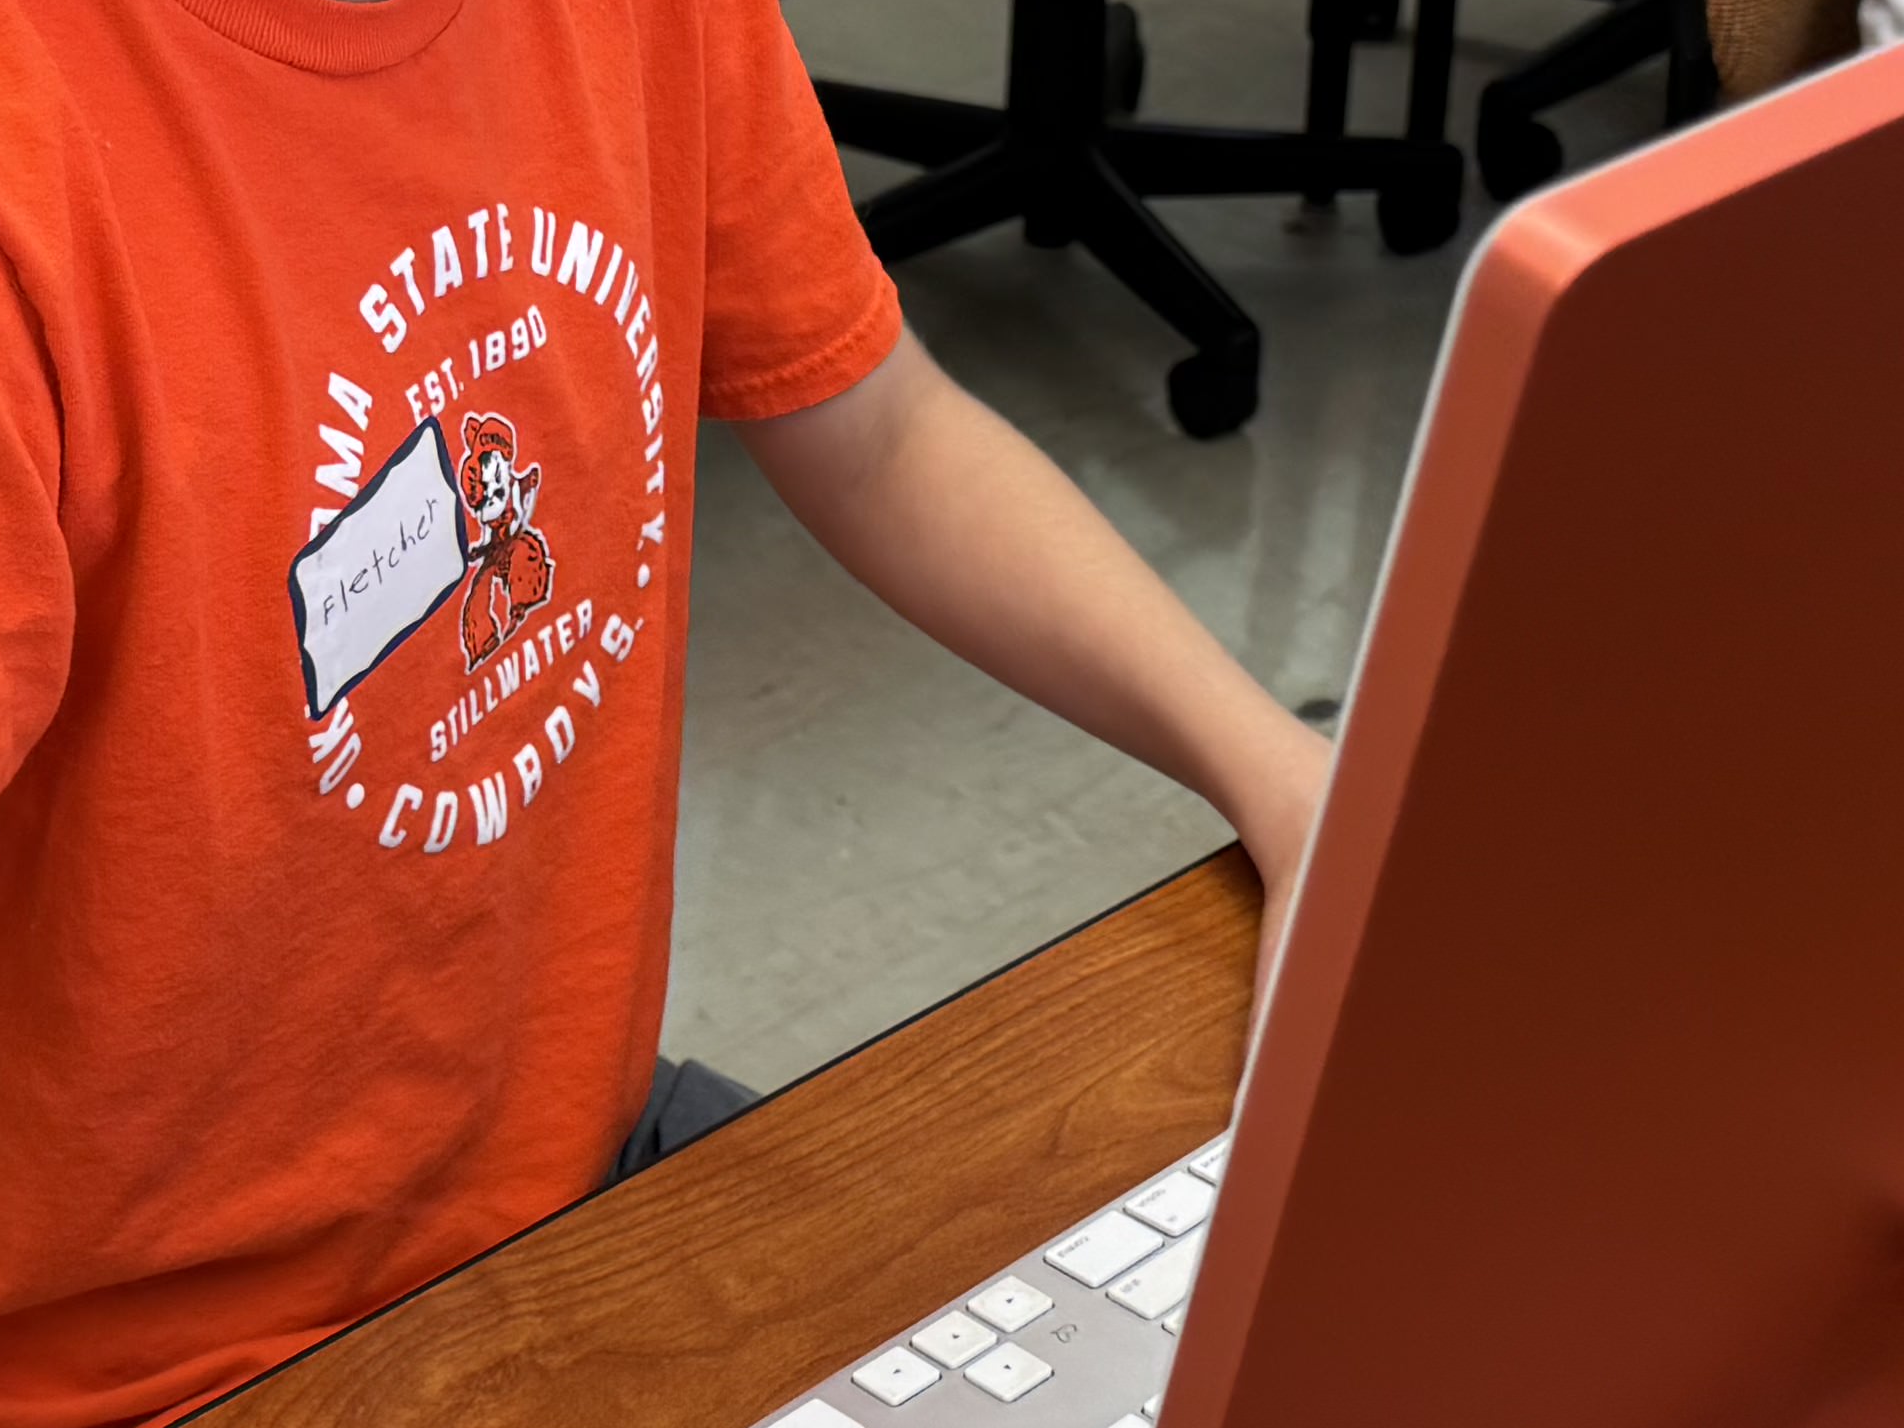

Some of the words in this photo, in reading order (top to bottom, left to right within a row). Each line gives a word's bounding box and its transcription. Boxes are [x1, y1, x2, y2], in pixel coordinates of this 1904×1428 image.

[359, 203, 514, 354] STATE
[531, 206, 666, 545] UNIVERSITY
[468, 304, 547, 380] 1890
[379, 614, 635, 852] COWBOYS
[430, 598, 593, 762] STILLWATER
